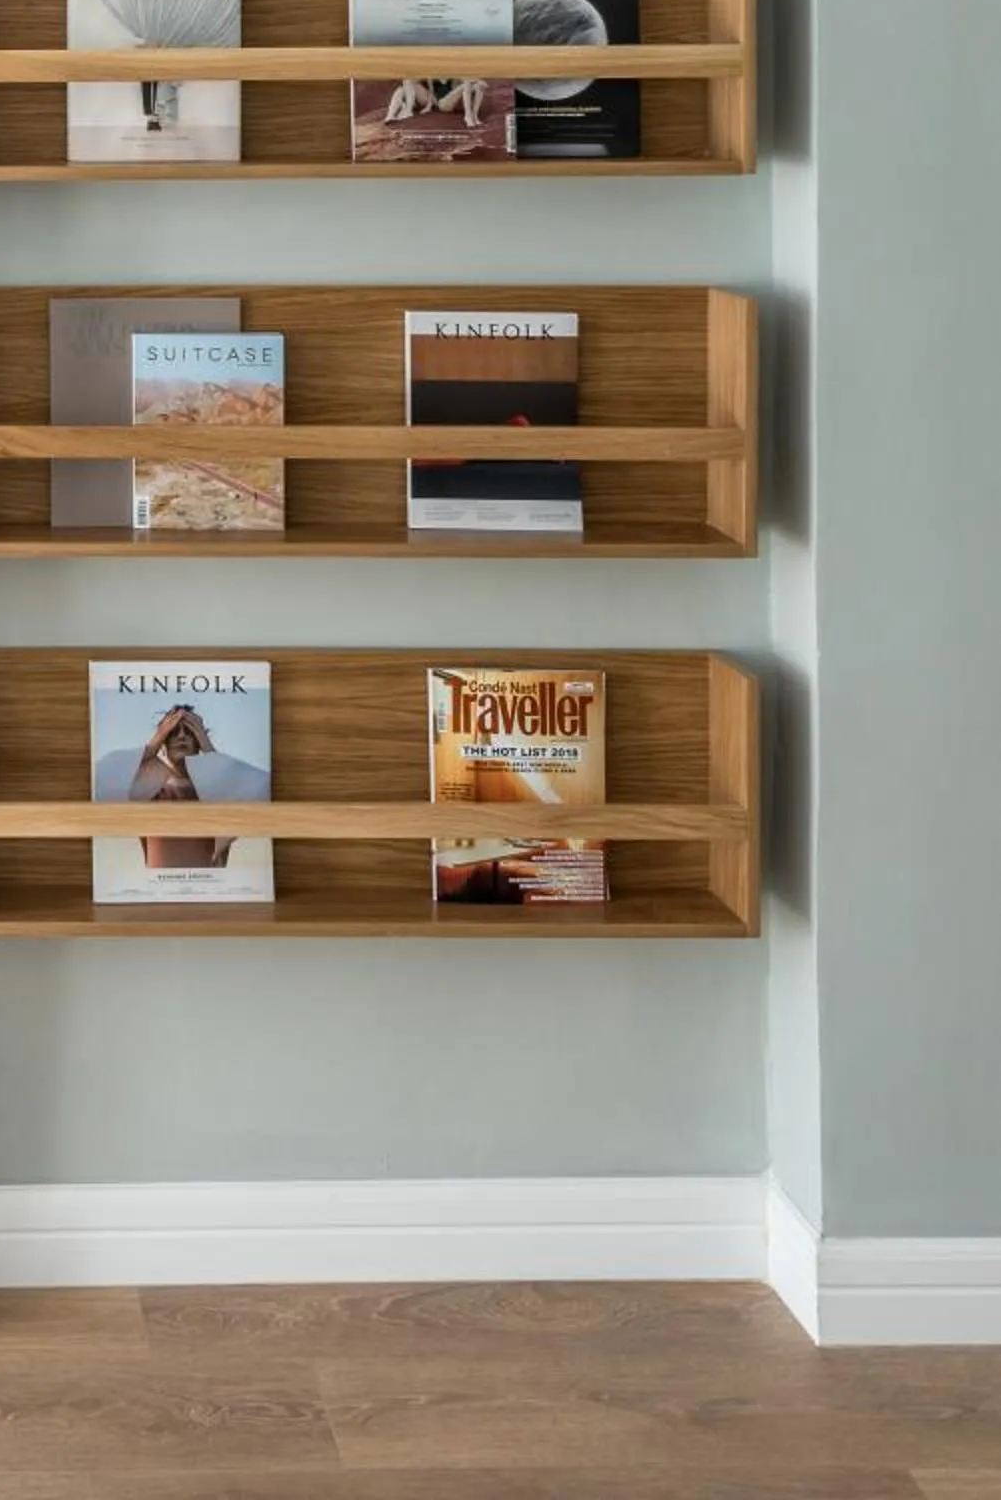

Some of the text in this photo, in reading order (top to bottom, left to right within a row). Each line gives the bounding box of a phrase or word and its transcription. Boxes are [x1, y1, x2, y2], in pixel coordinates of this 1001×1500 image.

[435, 323, 555, 340] KINFOLK
[147, 346, 274, 364] SUITCASE
[118, 675, 248, 694] KINFOLK
[510, 682, 538, 694] Nast
[444, 676, 594, 737] Traveller
[463, 746, 488, 757] THE
[491, 746, 517, 757] HOT
[521, 747, 547, 757] LIST
